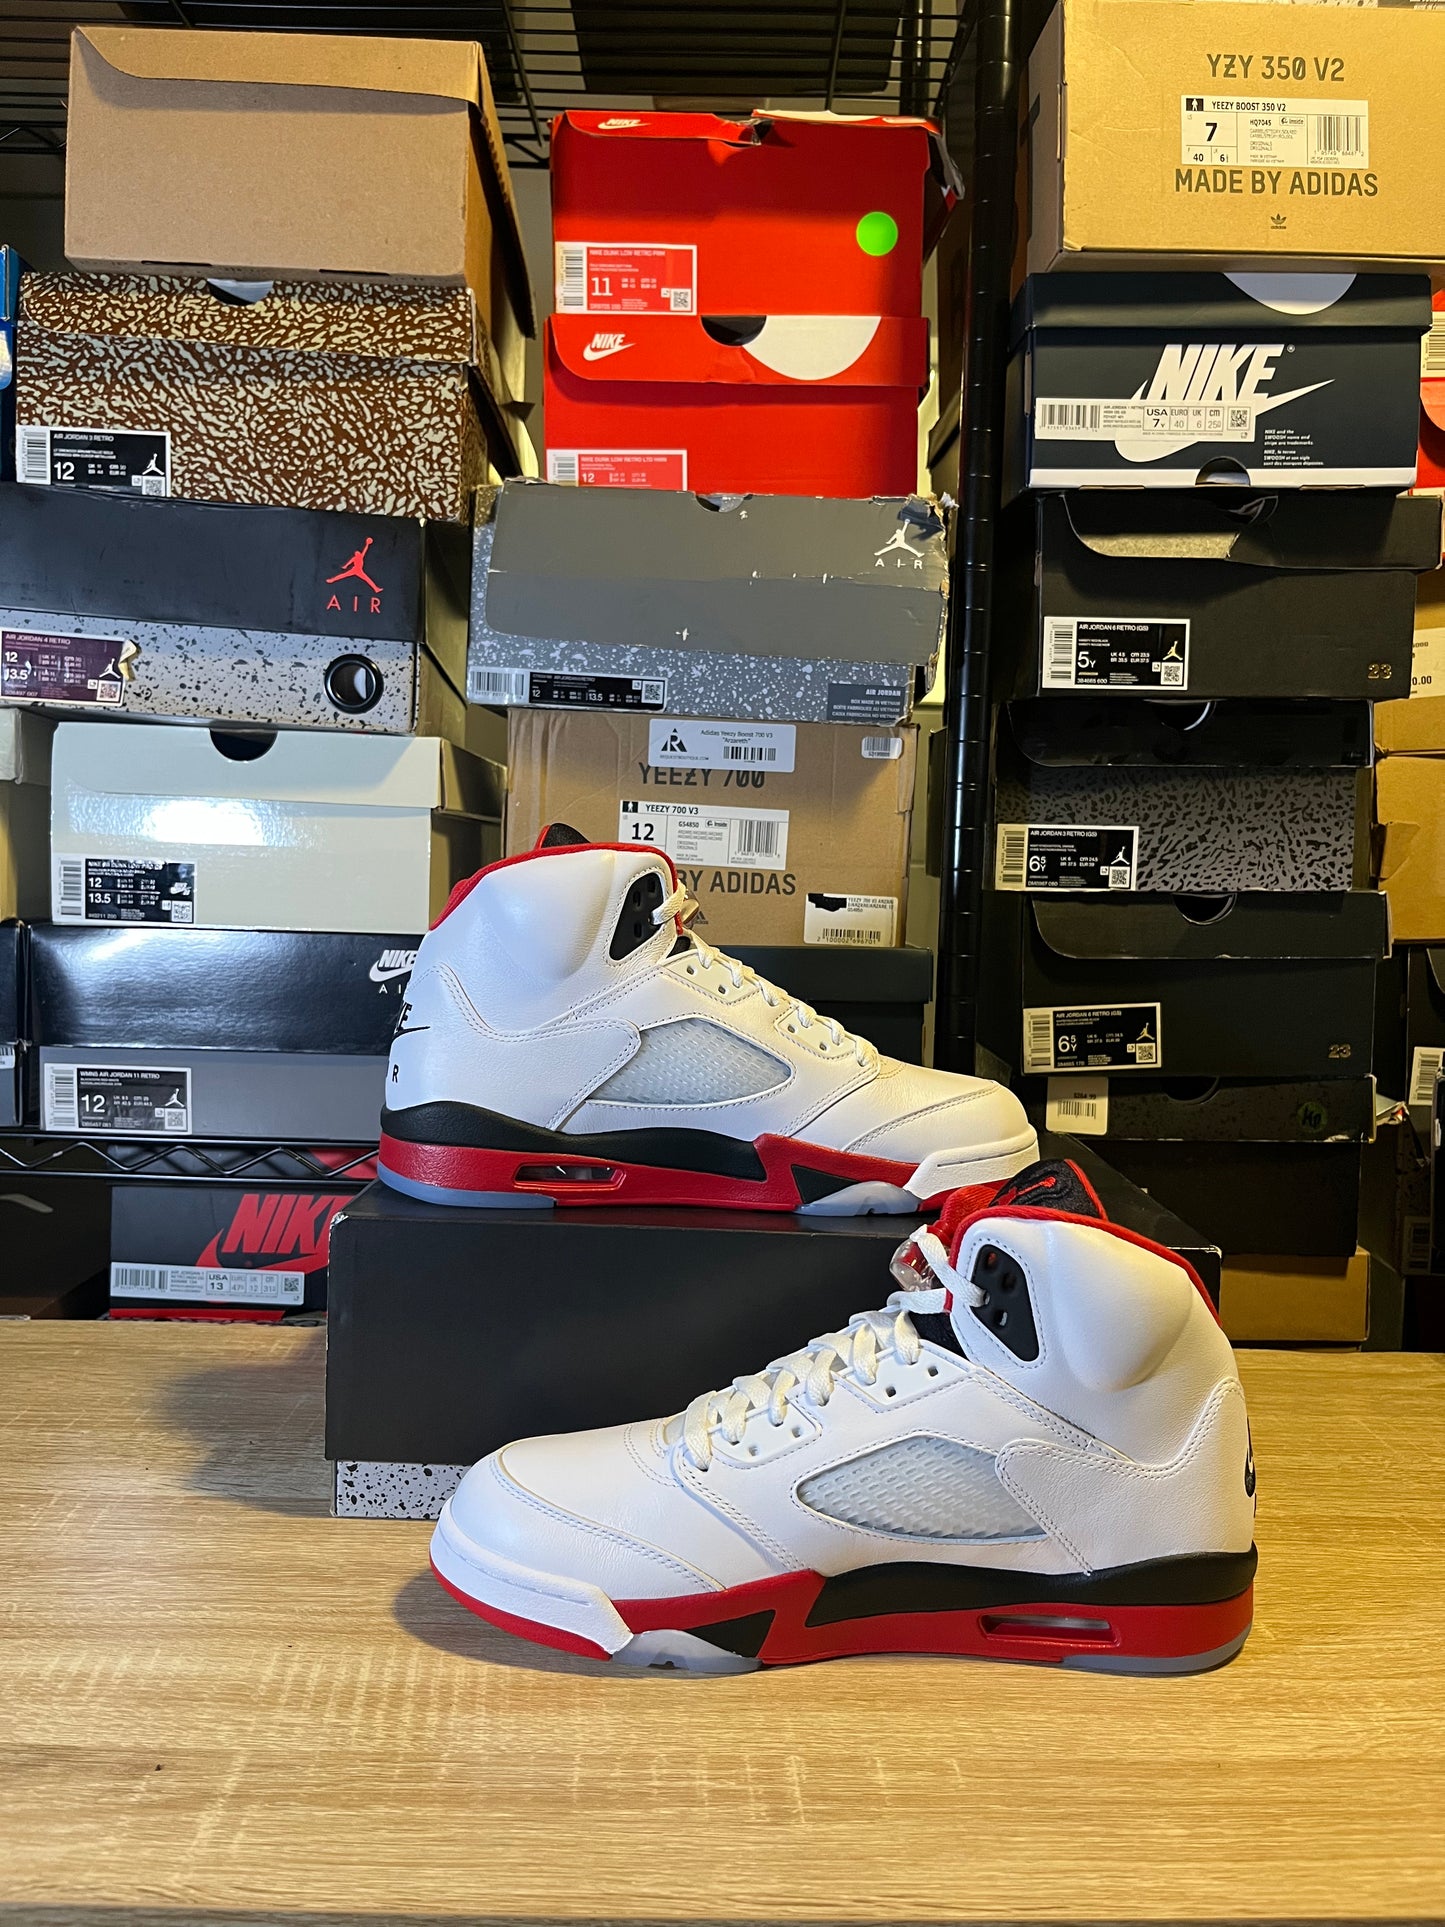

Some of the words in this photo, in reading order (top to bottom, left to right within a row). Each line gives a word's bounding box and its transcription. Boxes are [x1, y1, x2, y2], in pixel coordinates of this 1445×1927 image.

[1261, 56, 1306, 80] 350
[1314, 57, 1345, 82] V2
[1212, 101, 1234, 110] YEEZY
[1236, 101, 1260, 111] BOOST
[1261, 102, 1276, 111] 350
[1277, 103, 1287, 112] V2
[1205, 122, 1217, 142] 7
[1193, 153, 1204, 162] 40
[1175, 168, 1243, 193] MADE
[1251, 170, 1282, 194] BY
[1289, 171, 1378, 197] ADIDAS
[591, 277, 613, 297] 11
[591, 333, 626, 349] NIKE
[1146, 344, 1285, 400] NIKE
[1146, 408, 1168, 416] USA
[53, 461, 75, 480] 12
[582, 473, 595, 483] 12
[875, 558, 923, 570] AIR
[326, 594, 381, 614] AIR
[16, 634, 42, 642] JORDAN
[48, 637, 70, 645] RETRO
[5, 651, 18, 662] 12
[6, 668, 28, 680] 13.5
[1368, 664, 1392, 679] 23
[1412, 676, 1432, 685] 0.00
[532, 689, 541, 698] 12
[588, 693, 603, 702] 13.5
[865, 688, 876, 696] AIR
[877, 689, 901, 697] JORDAN
[720, 730, 736, 738] Yeezy
[638, 762, 712, 786] YEEZY
[646, 803, 671, 814] YEEZY
[672, 805, 687, 814] 700
[688, 806, 699, 815] V3
[631, 822, 654, 841] 12
[88, 877, 102, 888] 12
[710, 871, 796, 896] ADIDAS
[88, 893, 112, 904] 13.5
[379, 983, 402, 994] AI
[1328, 1044, 1351, 1058] 23
[81, 1094, 106, 1113] 12
[210, 1282, 224, 1290] 13
